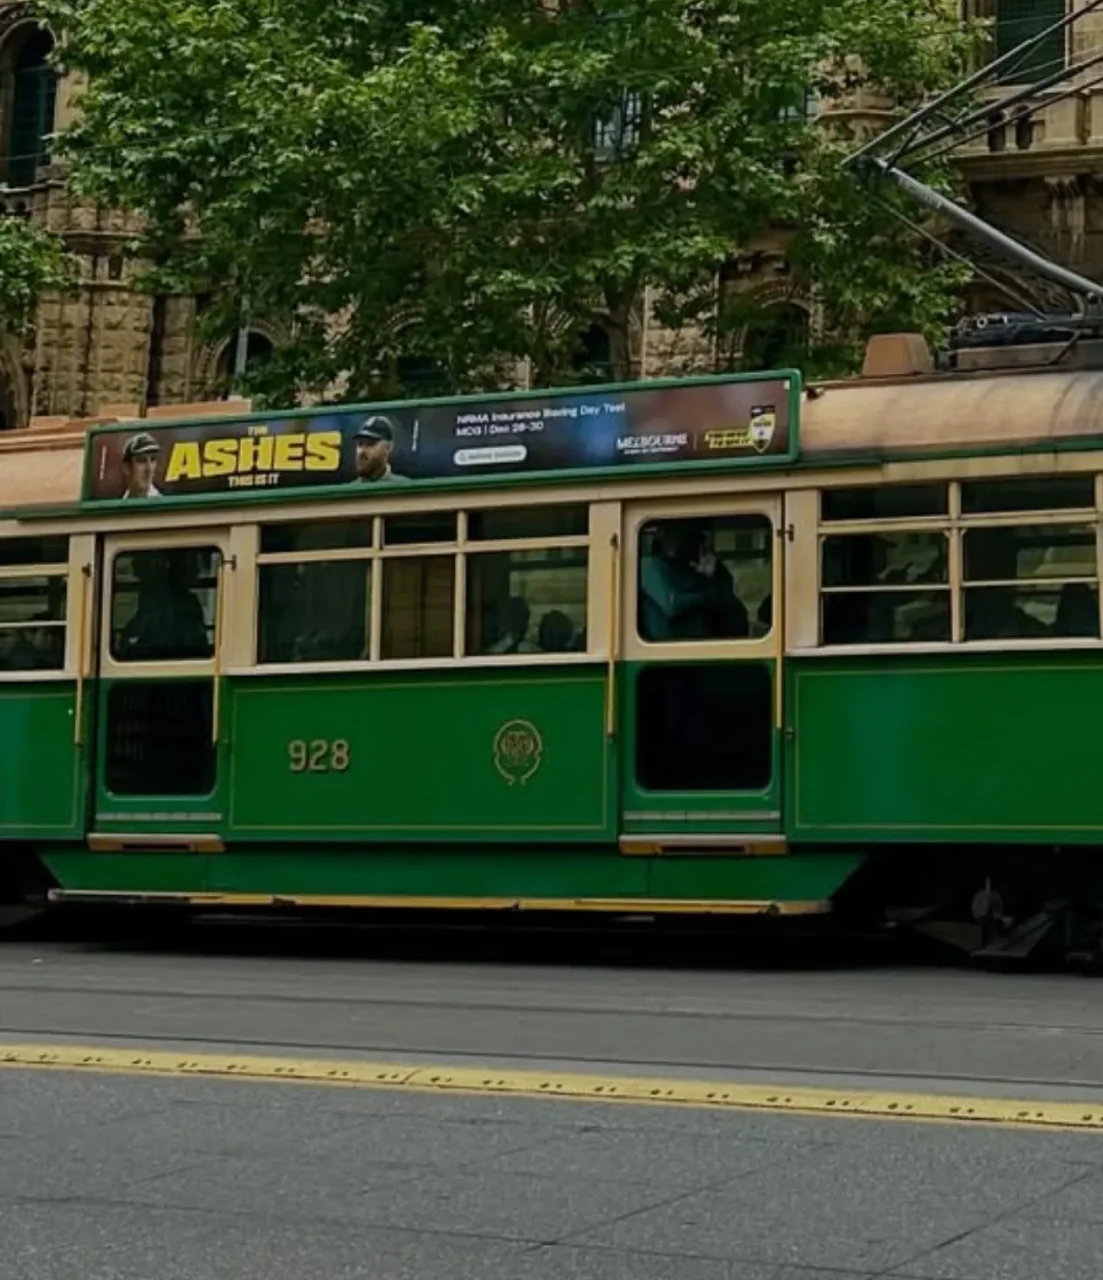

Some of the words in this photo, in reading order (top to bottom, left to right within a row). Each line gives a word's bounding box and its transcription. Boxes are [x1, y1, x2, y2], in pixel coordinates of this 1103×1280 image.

[491, 409, 541, 422] Insurance
[580, 404, 601, 417] Day
[164, 430, 342, 483] ASHES
[268, 472, 280, 486] IT
[288, 738, 350, 772] 928
